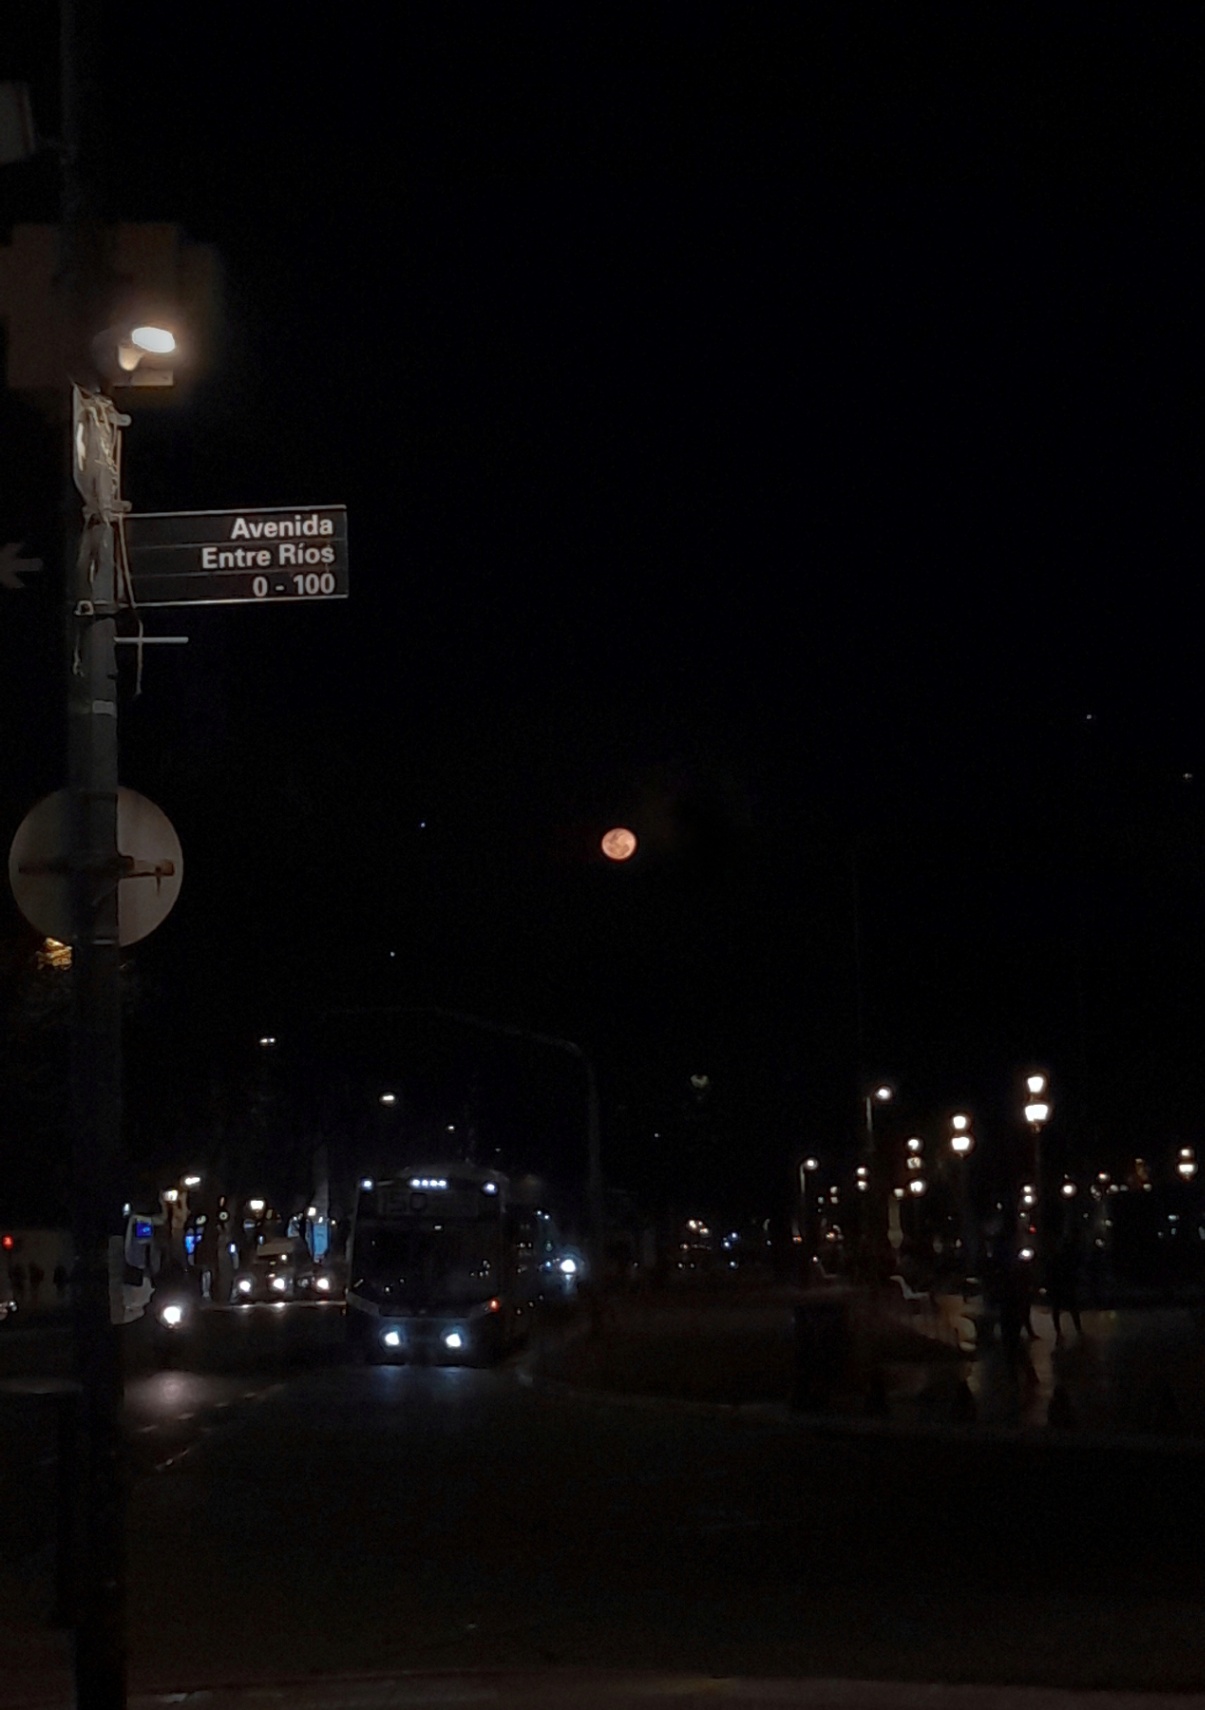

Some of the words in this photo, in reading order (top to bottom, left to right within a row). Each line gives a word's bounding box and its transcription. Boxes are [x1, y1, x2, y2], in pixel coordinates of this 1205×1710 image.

[230, 514, 334, 539] Avenida
[201, 546, 272, 570] Entre
[278, 542, 336, 565] Ríos
[252, 575, 269, 598] 0
[293, 572, 336, 596] 100
